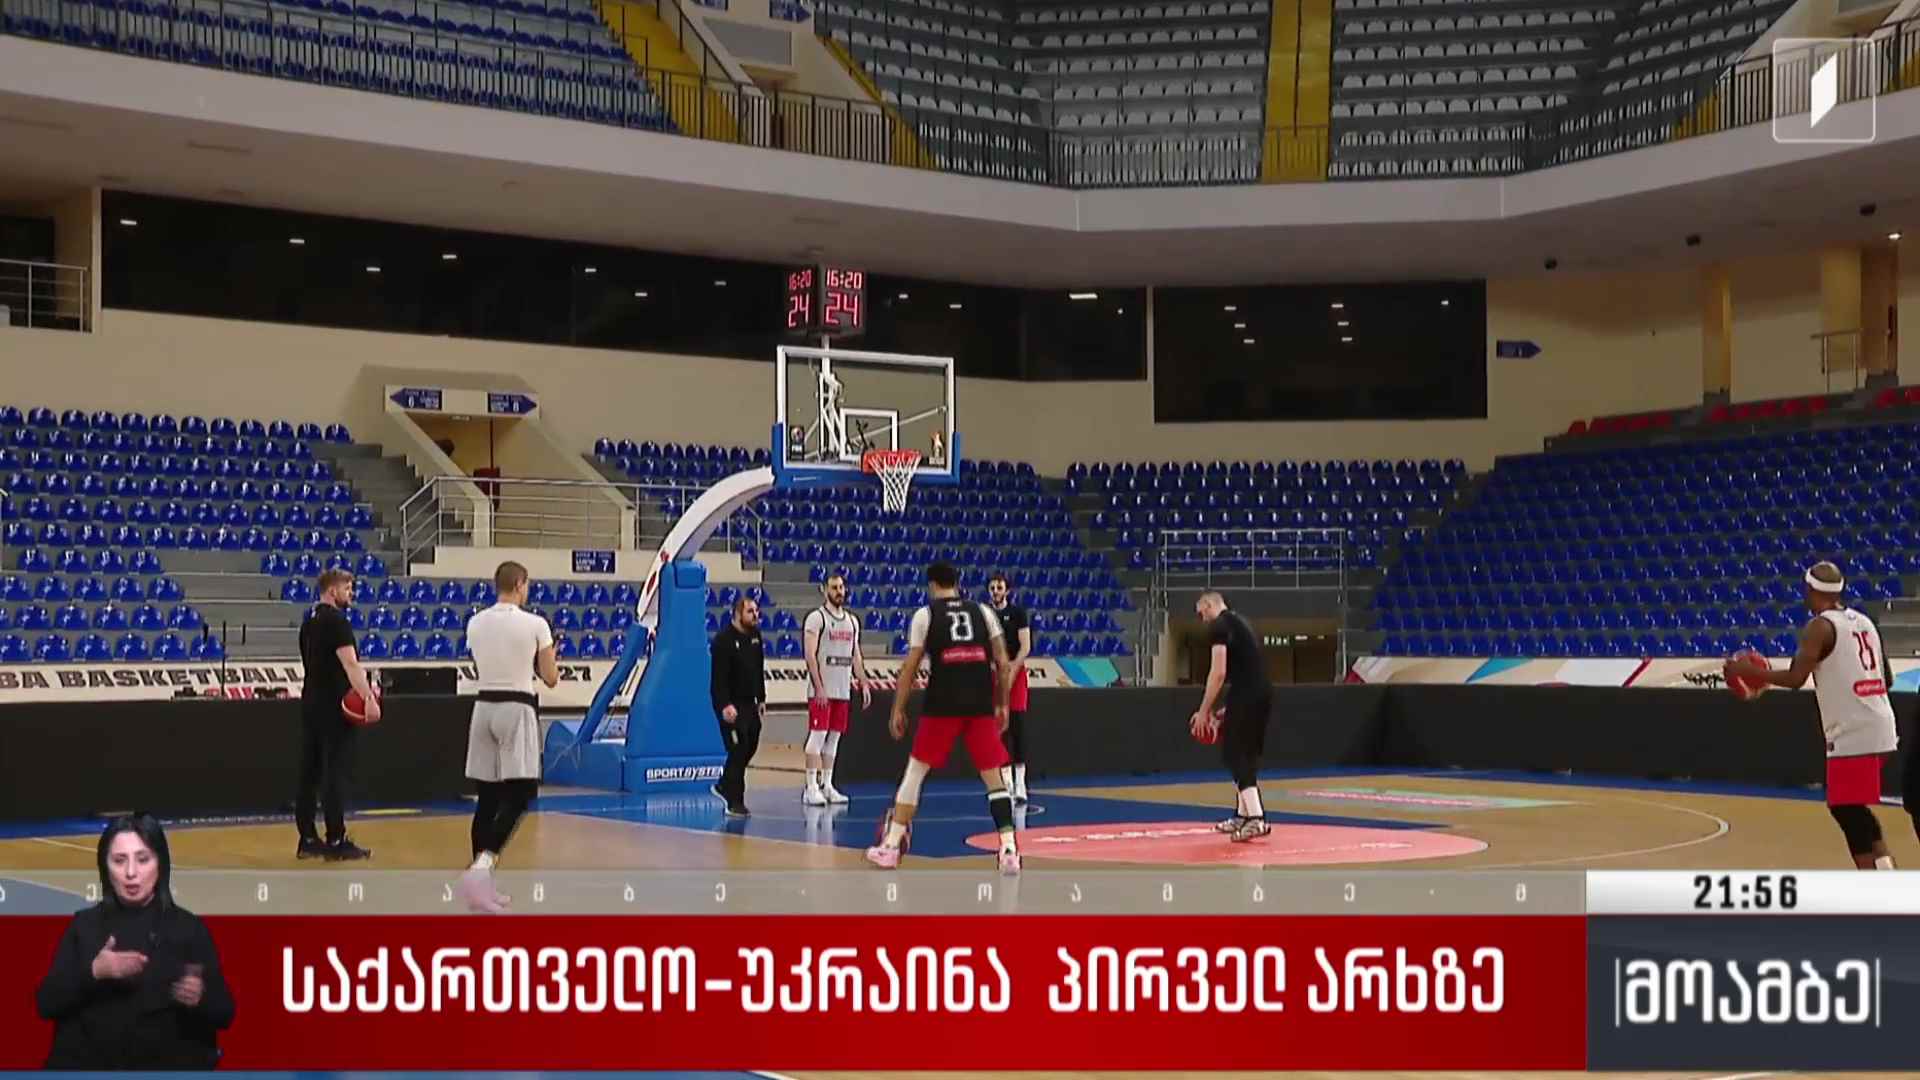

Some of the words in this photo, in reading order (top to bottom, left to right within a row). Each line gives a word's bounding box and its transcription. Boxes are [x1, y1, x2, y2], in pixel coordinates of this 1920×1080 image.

[789, 269, 812, 290] 16:20
[826, 268, 862, 290] 16:20
[788, 292, 809, 328] 24
[825, 292, 858, 328] 24
[601, 559, 609, 571] 7
[946, 611, 974, 641] 23
[56, 667, 304, 688] BASKETBALL
